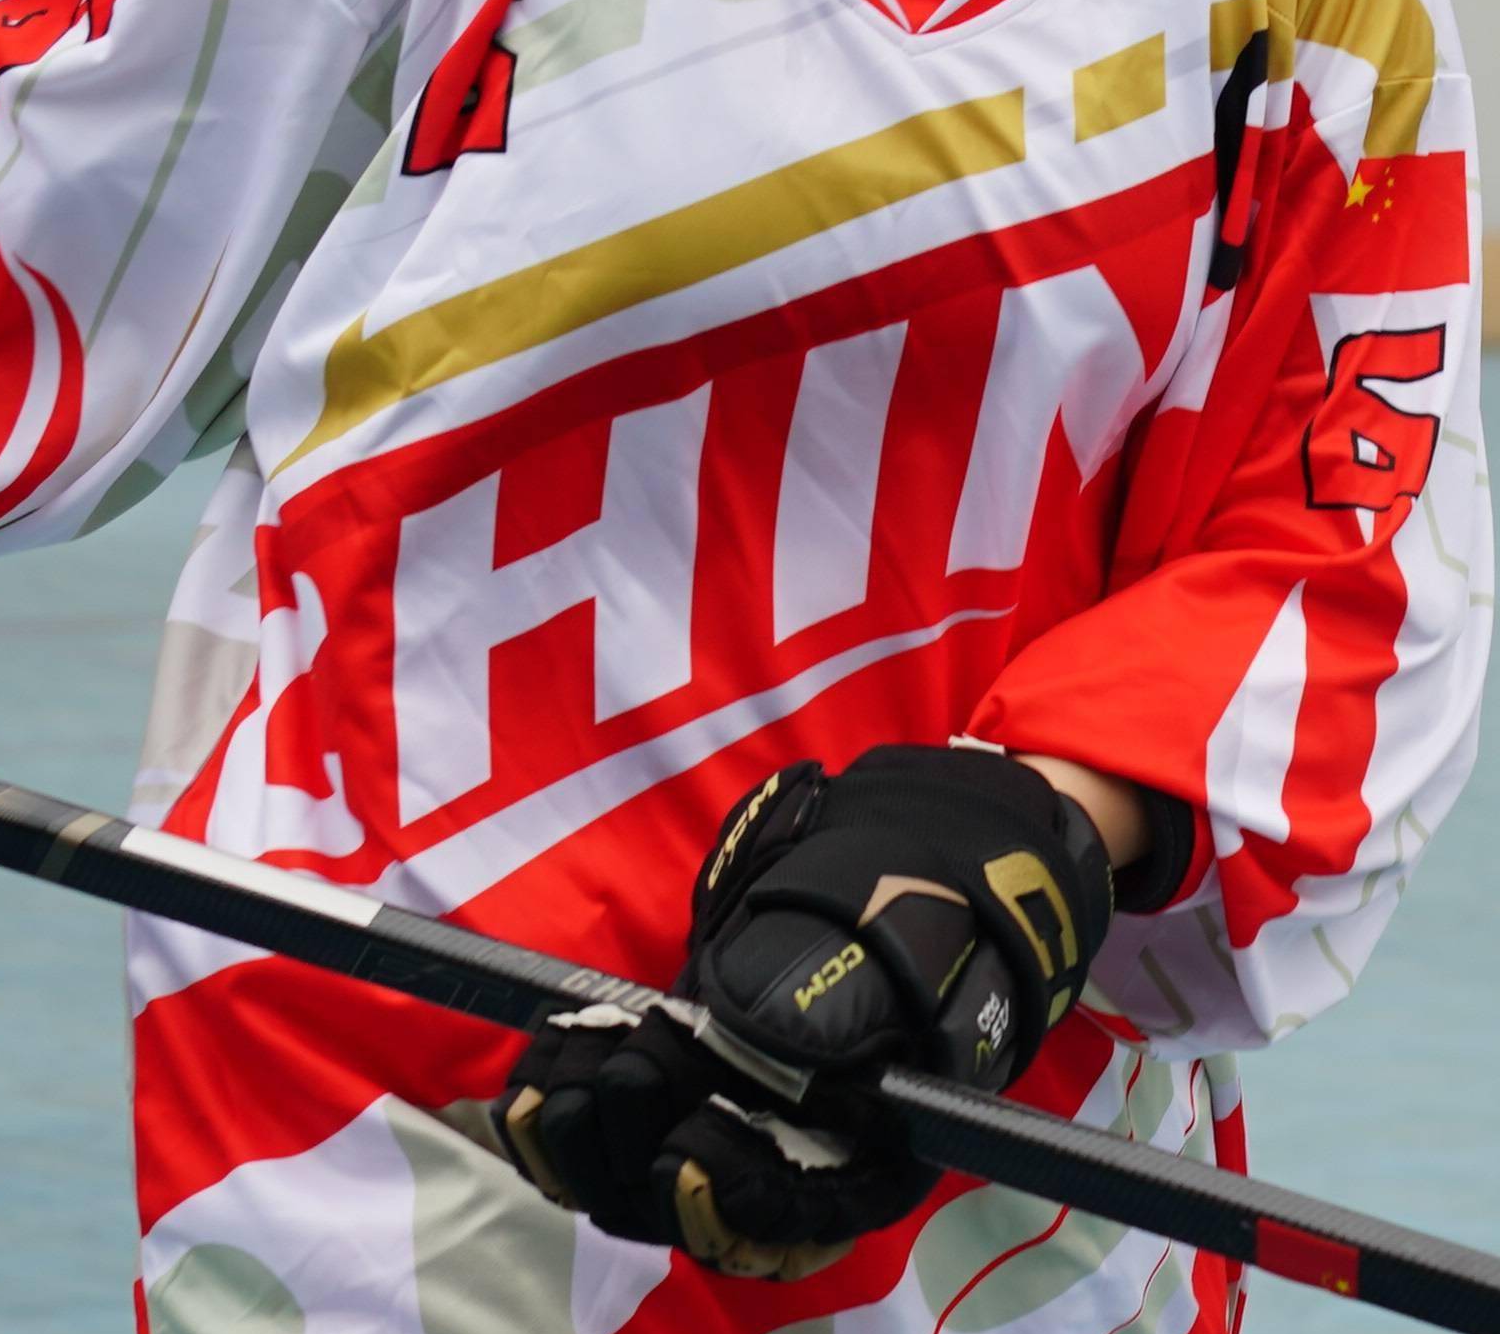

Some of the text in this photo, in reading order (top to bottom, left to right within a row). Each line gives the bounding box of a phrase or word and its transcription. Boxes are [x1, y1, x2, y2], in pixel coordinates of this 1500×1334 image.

[1302, 324, 1447, 511] 6
[706, 771, 780, 891] CCM
[560, 967, 666, 1021] GHO
[793, 942, 866, 1013] CCM
